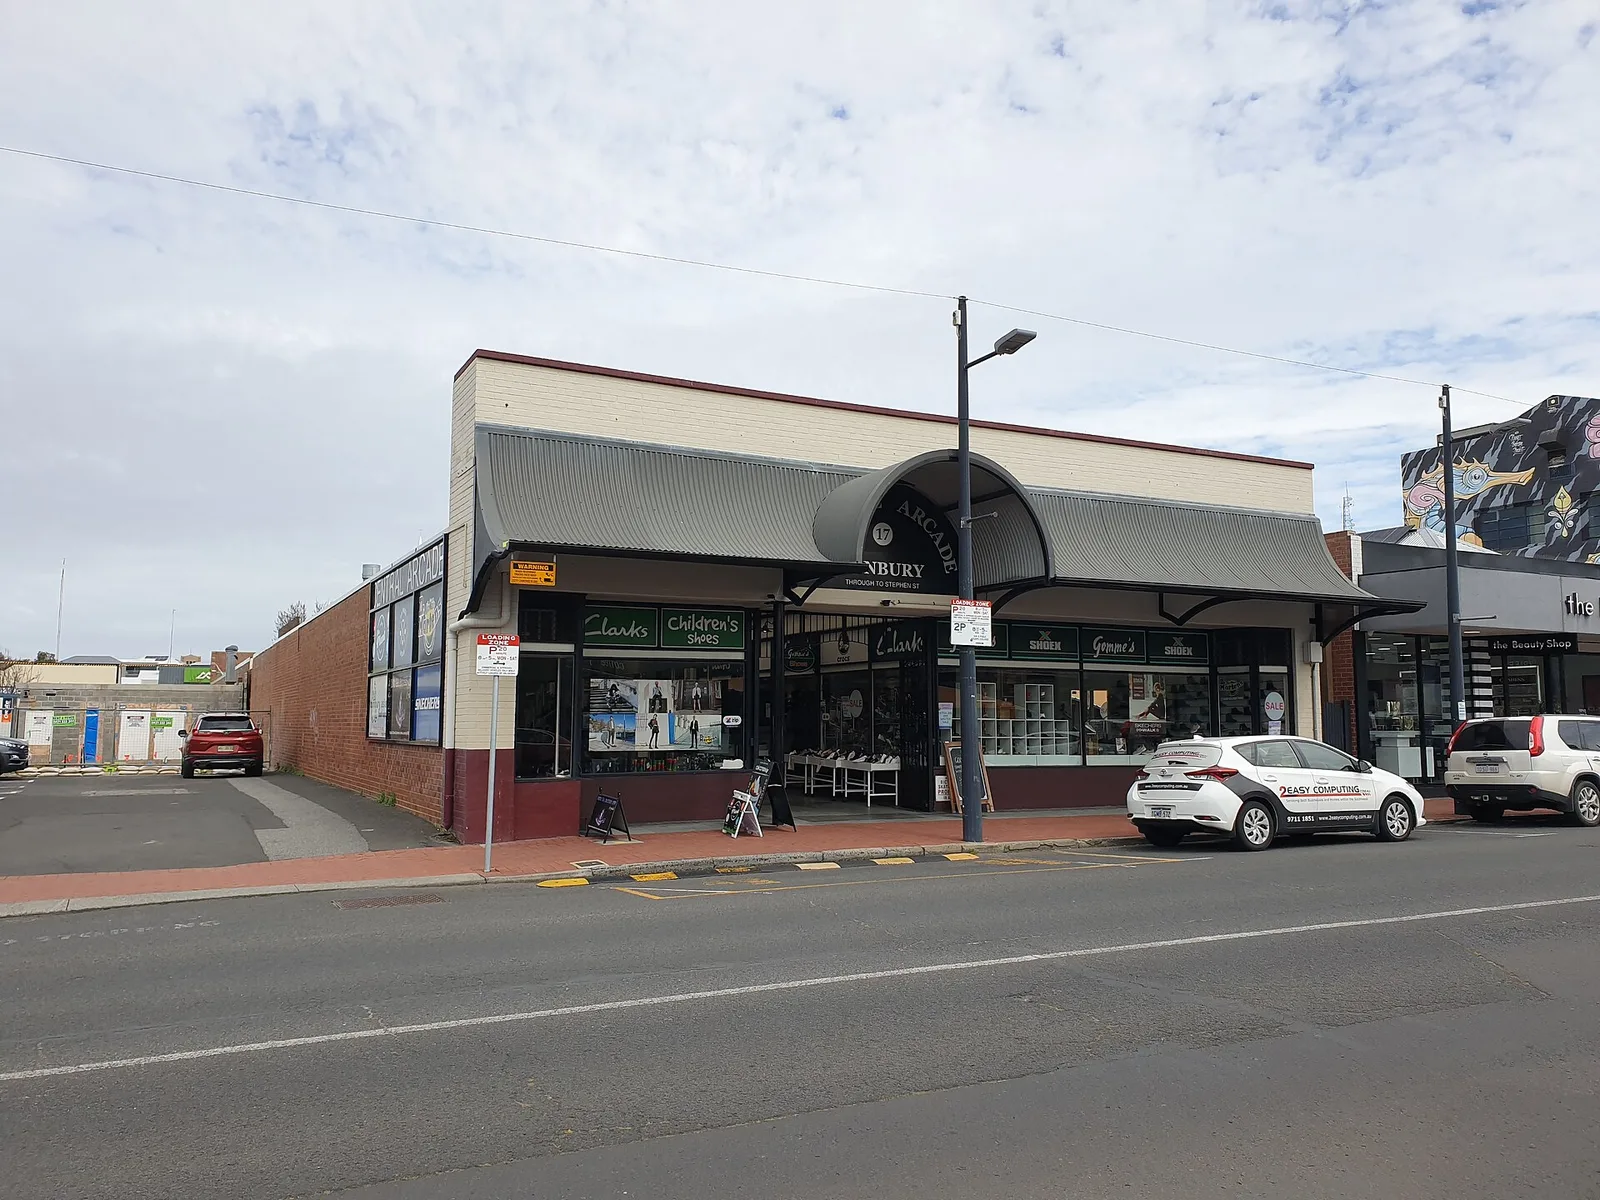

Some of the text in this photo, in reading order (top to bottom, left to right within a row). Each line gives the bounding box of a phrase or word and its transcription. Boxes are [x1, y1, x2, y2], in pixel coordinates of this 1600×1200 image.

[875, 527, 890, 540] 17
[896, 500, 958, 574] ARCADE
[375, 542, 443, 609] ENTRAL ARCADE
[863, 561, 925, 578] NBURY
[846, 579, 875, 587] THROUGH
[885, 581, 912, 589] STEPHEN
[1567, 592, 1594, 616] the
[585, 614, 649, 638] Clarks
[667, 614, 739, 632] Children's
[954, 622, 967, 631] 2P
[687, 632, 720, 645] shoes
[876, 627, 923, 656] Clark
[1493, 638, 1571, 650] the Beauty Shop
[489, 646, 497, 655] P
[1093, 635, 1135, 658] Gomme's
[1265, 702, 1284, 711] SALE
[1313, 785, 1360, 794] COMPUTING
